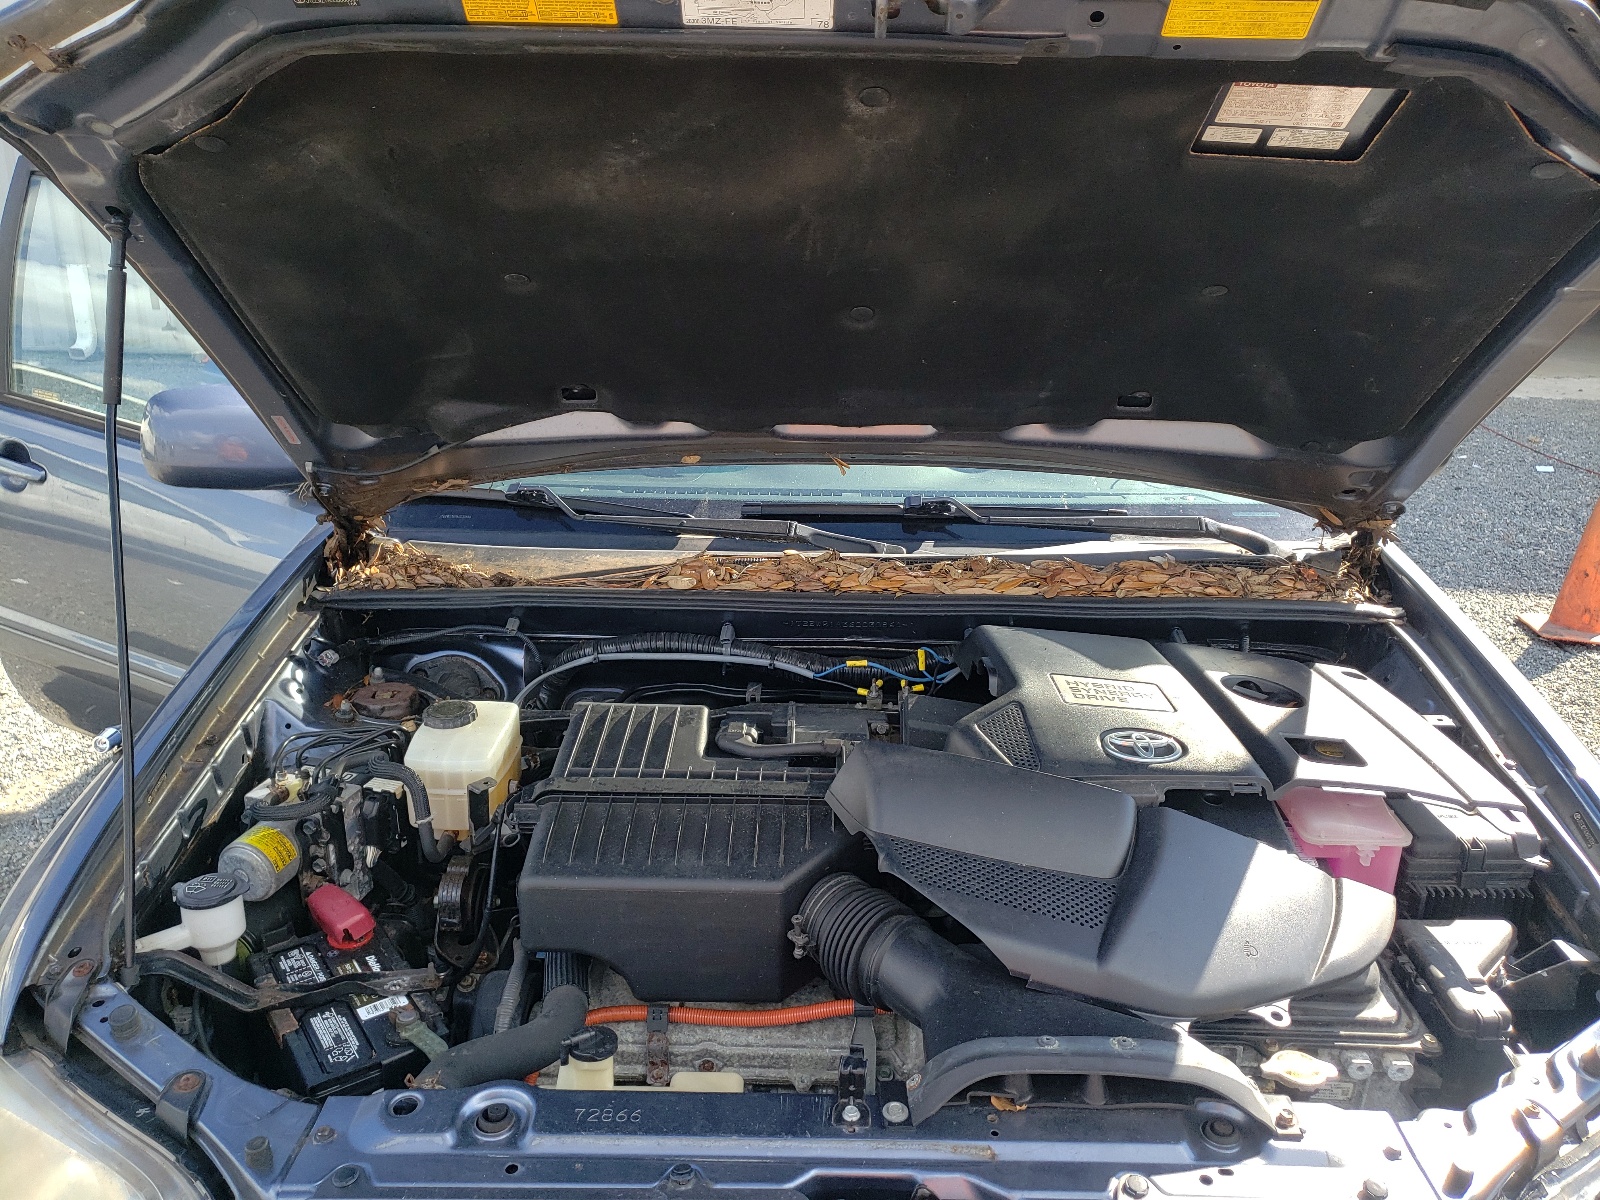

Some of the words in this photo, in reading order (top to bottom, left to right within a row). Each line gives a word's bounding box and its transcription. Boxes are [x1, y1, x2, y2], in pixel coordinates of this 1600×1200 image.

[701, 17, 737, 25] 3MZ-FE
[1065, 680, 1135, 691] HYBRID
[1068, 686, 1154, 699] SYNERGY
[1072, 692, 1131, 703] DRIVE
[365, 955, 381, 972] DieHa
[574, 1108, 642, 1122] 72866
